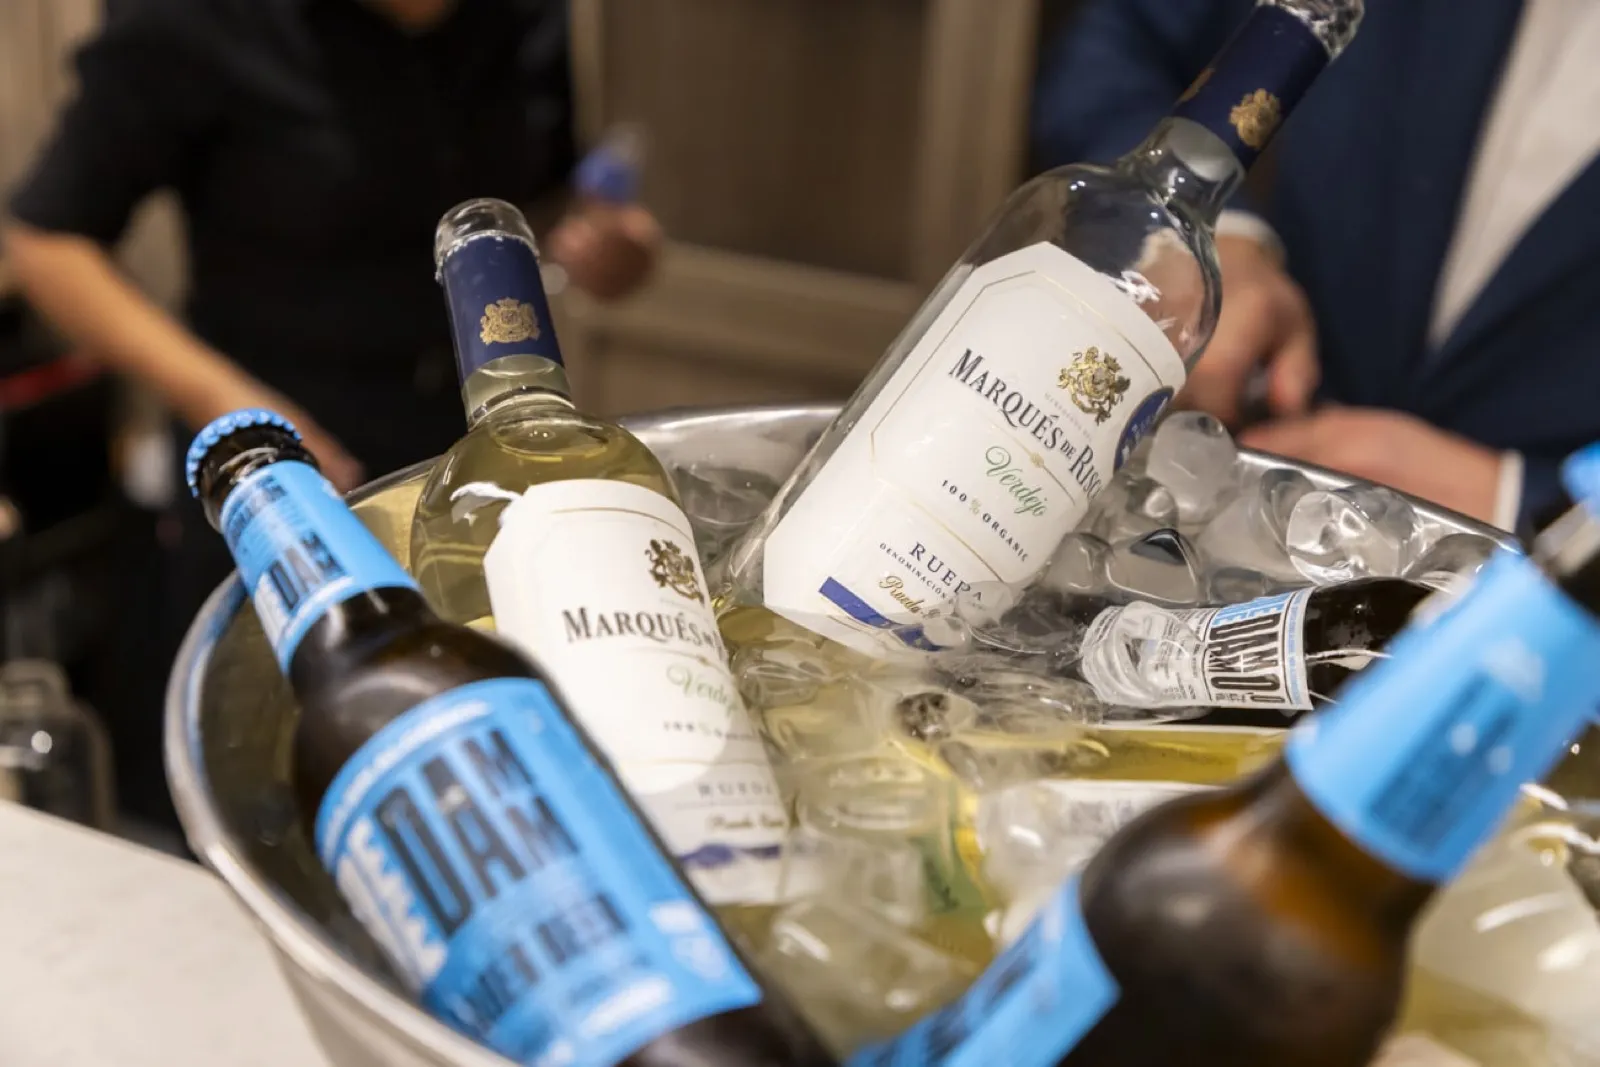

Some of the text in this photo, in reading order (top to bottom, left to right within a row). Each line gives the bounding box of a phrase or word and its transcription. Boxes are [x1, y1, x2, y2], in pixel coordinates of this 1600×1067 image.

[947, 347, 1064, 450] MARQUÉS
[1060, 438, 1077, 460] DE
[984, 445, 1047, 517] Verdejo
[982, 512, 1029, 563] ORGANIC
[878, 574, 926, 614] Rueda
[561, 606, 704, 646] MARQUÉS
[1207, 612, 1281, 673] DAMM
[373, 728, 582, 940] DAMM
